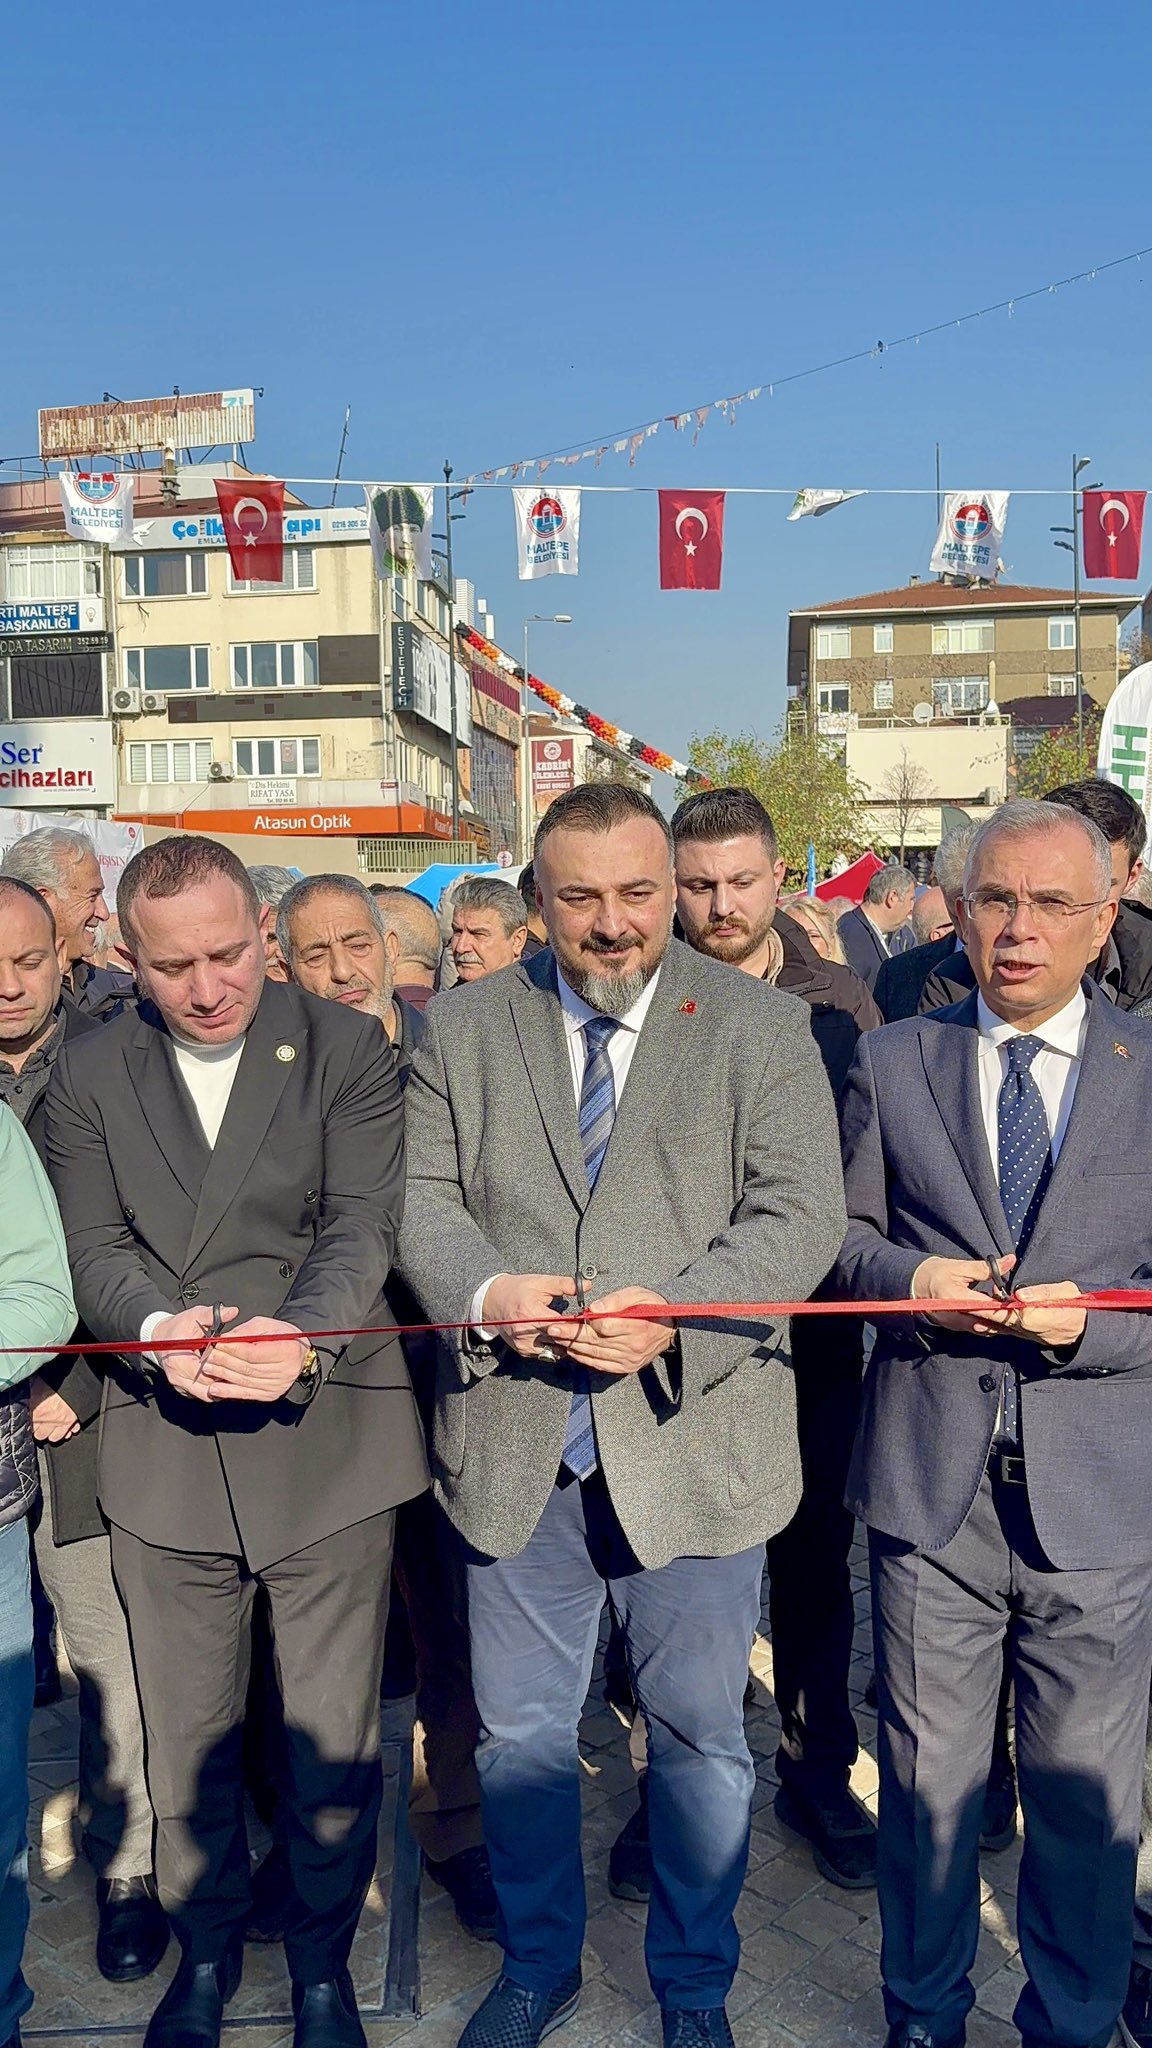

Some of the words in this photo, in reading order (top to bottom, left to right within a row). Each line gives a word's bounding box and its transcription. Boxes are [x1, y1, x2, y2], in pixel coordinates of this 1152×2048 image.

[70, 507, 124, 518] MALTEPE
[71, 517, 124, 529] BELEDİYESİ
[286, 518, 321, 536] apı
[527, 540, 569, 555] MALTEPE
[943, 542, 991, 557] MALTEPE
[527, 551, 569, 564] BELEDİYESİ
[941, 552, 990, 566] BELEDİYESİ
[19, 604, 77, 618] MALTEPE
[0, 616, 71, 633] BAŞKANLIĞI
[25, 638, 72, 653] TASARIM
[397, 626, 408, 706] ESTETECH
[0, 767, 93, 788] cihazları
[254, 816, 306, 829] Atasun
[310, 813, 352, 831] Optik
